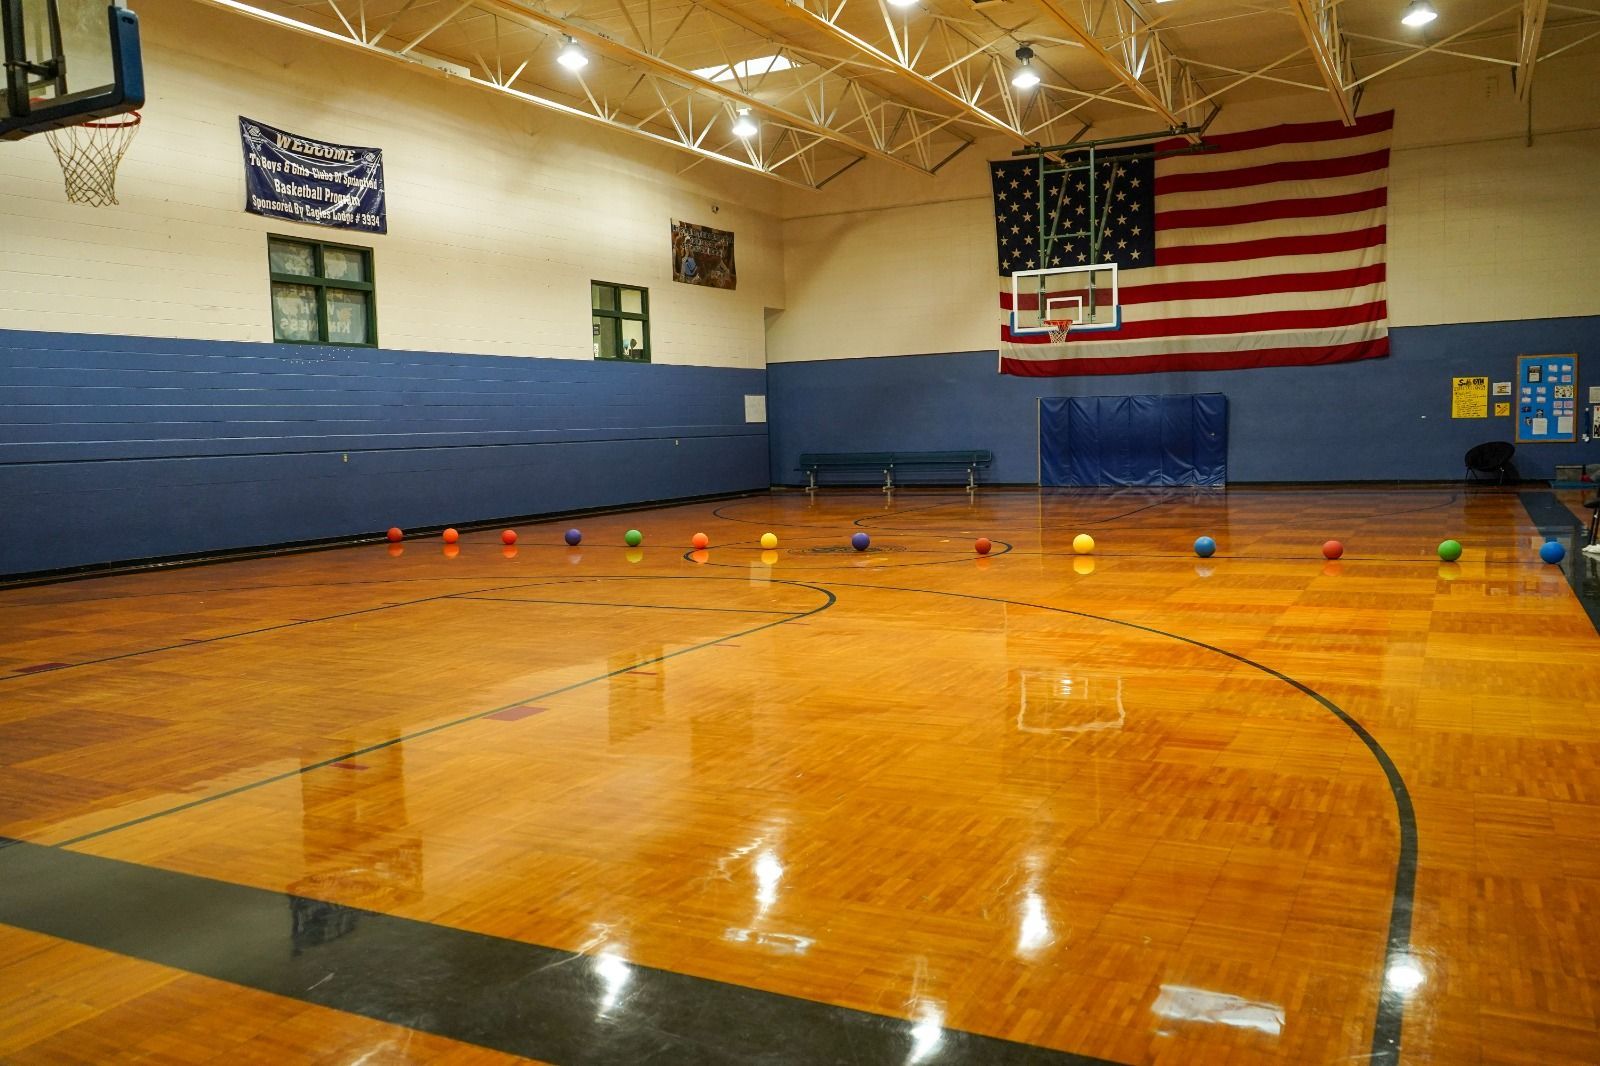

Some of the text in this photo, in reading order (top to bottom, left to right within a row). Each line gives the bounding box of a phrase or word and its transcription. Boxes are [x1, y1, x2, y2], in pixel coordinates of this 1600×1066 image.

[276, 132, 355, 163] WELCOME
[249, 152, 260, 166] To
[260, 155, 281, 173] Boys
[283, 160, 291, 173] &
[291, 162, 310, 176] Girls
[311, 167, 333, 181] Clubs
[343, 173, 378, 190] Springfield
[273, 178, 361, 207] Basketball Program
[251, 194, 380, 227] Sponsored By Eagles Lodge # 3934
